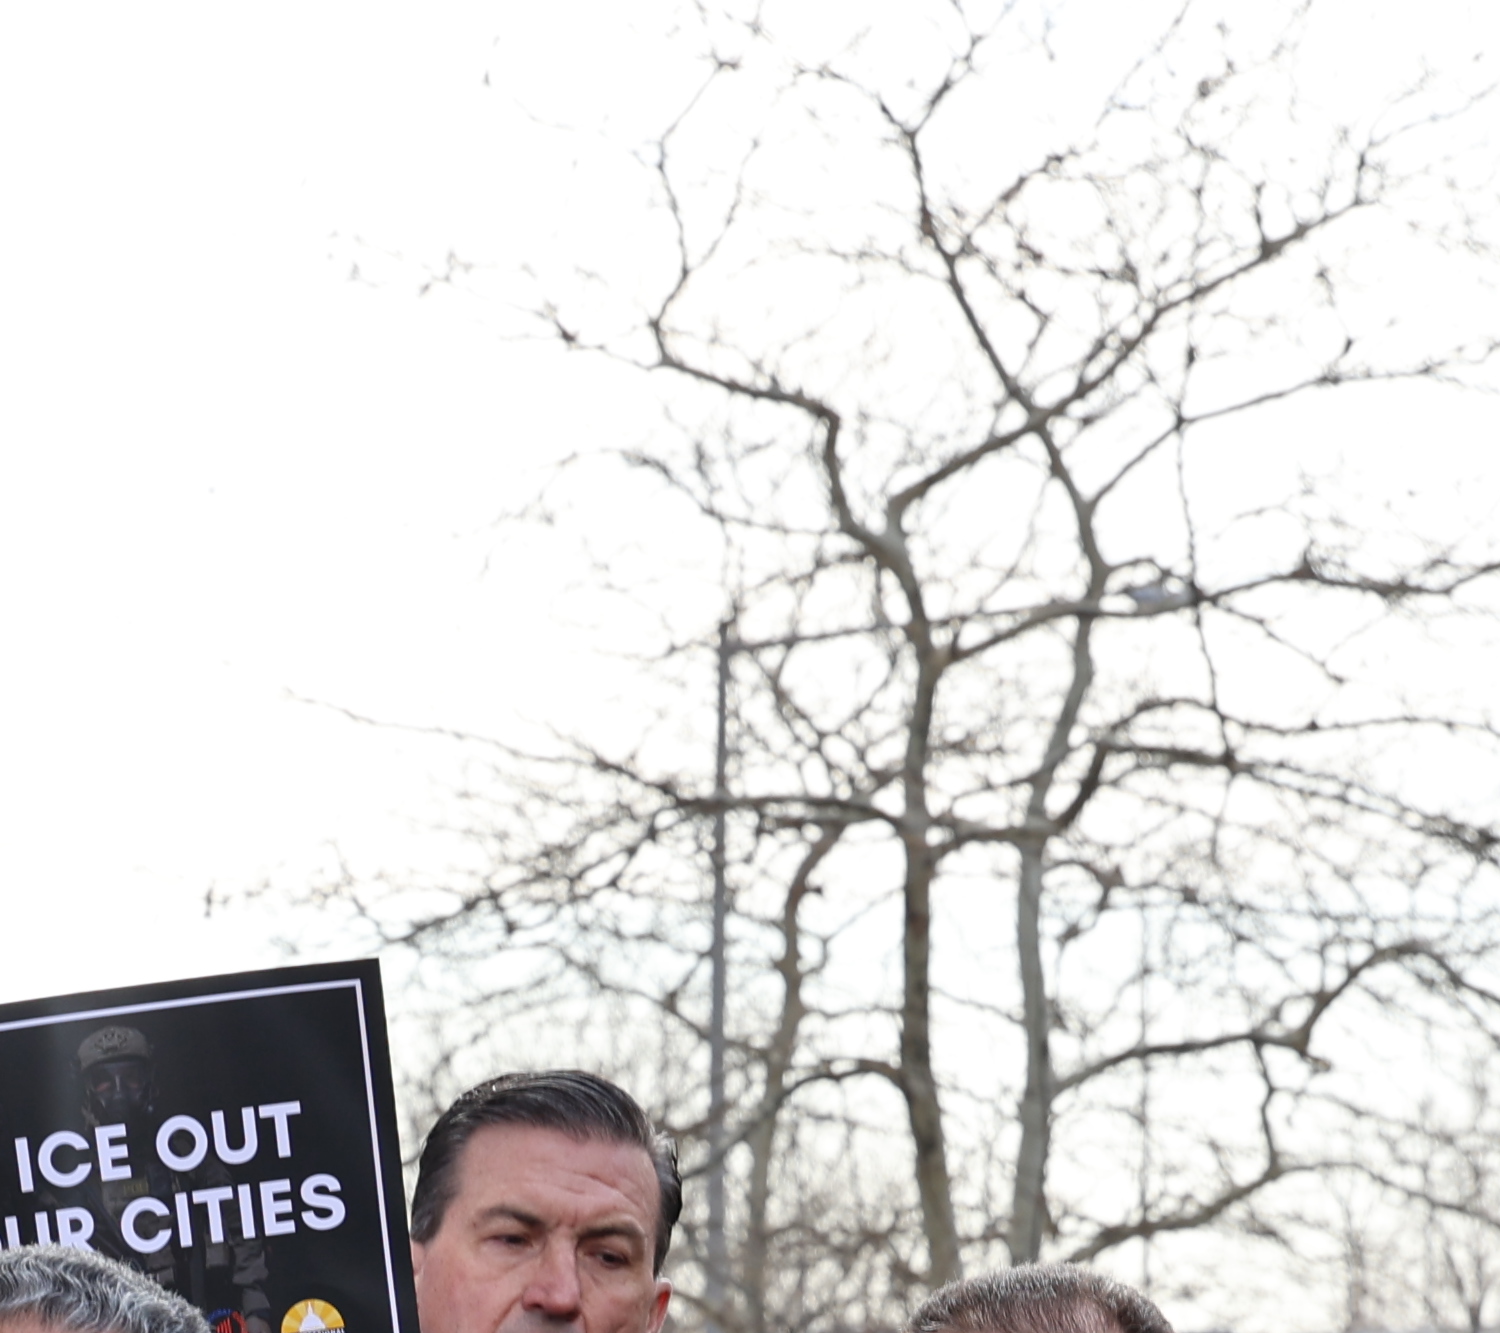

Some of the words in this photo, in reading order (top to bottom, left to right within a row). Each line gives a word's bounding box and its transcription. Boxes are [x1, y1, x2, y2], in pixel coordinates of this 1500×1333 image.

[14, 1123, 133, 1193] ICE
[155, 1100, 301, 1172] OUT
[120, 1173, 347, 1255] CITIES
